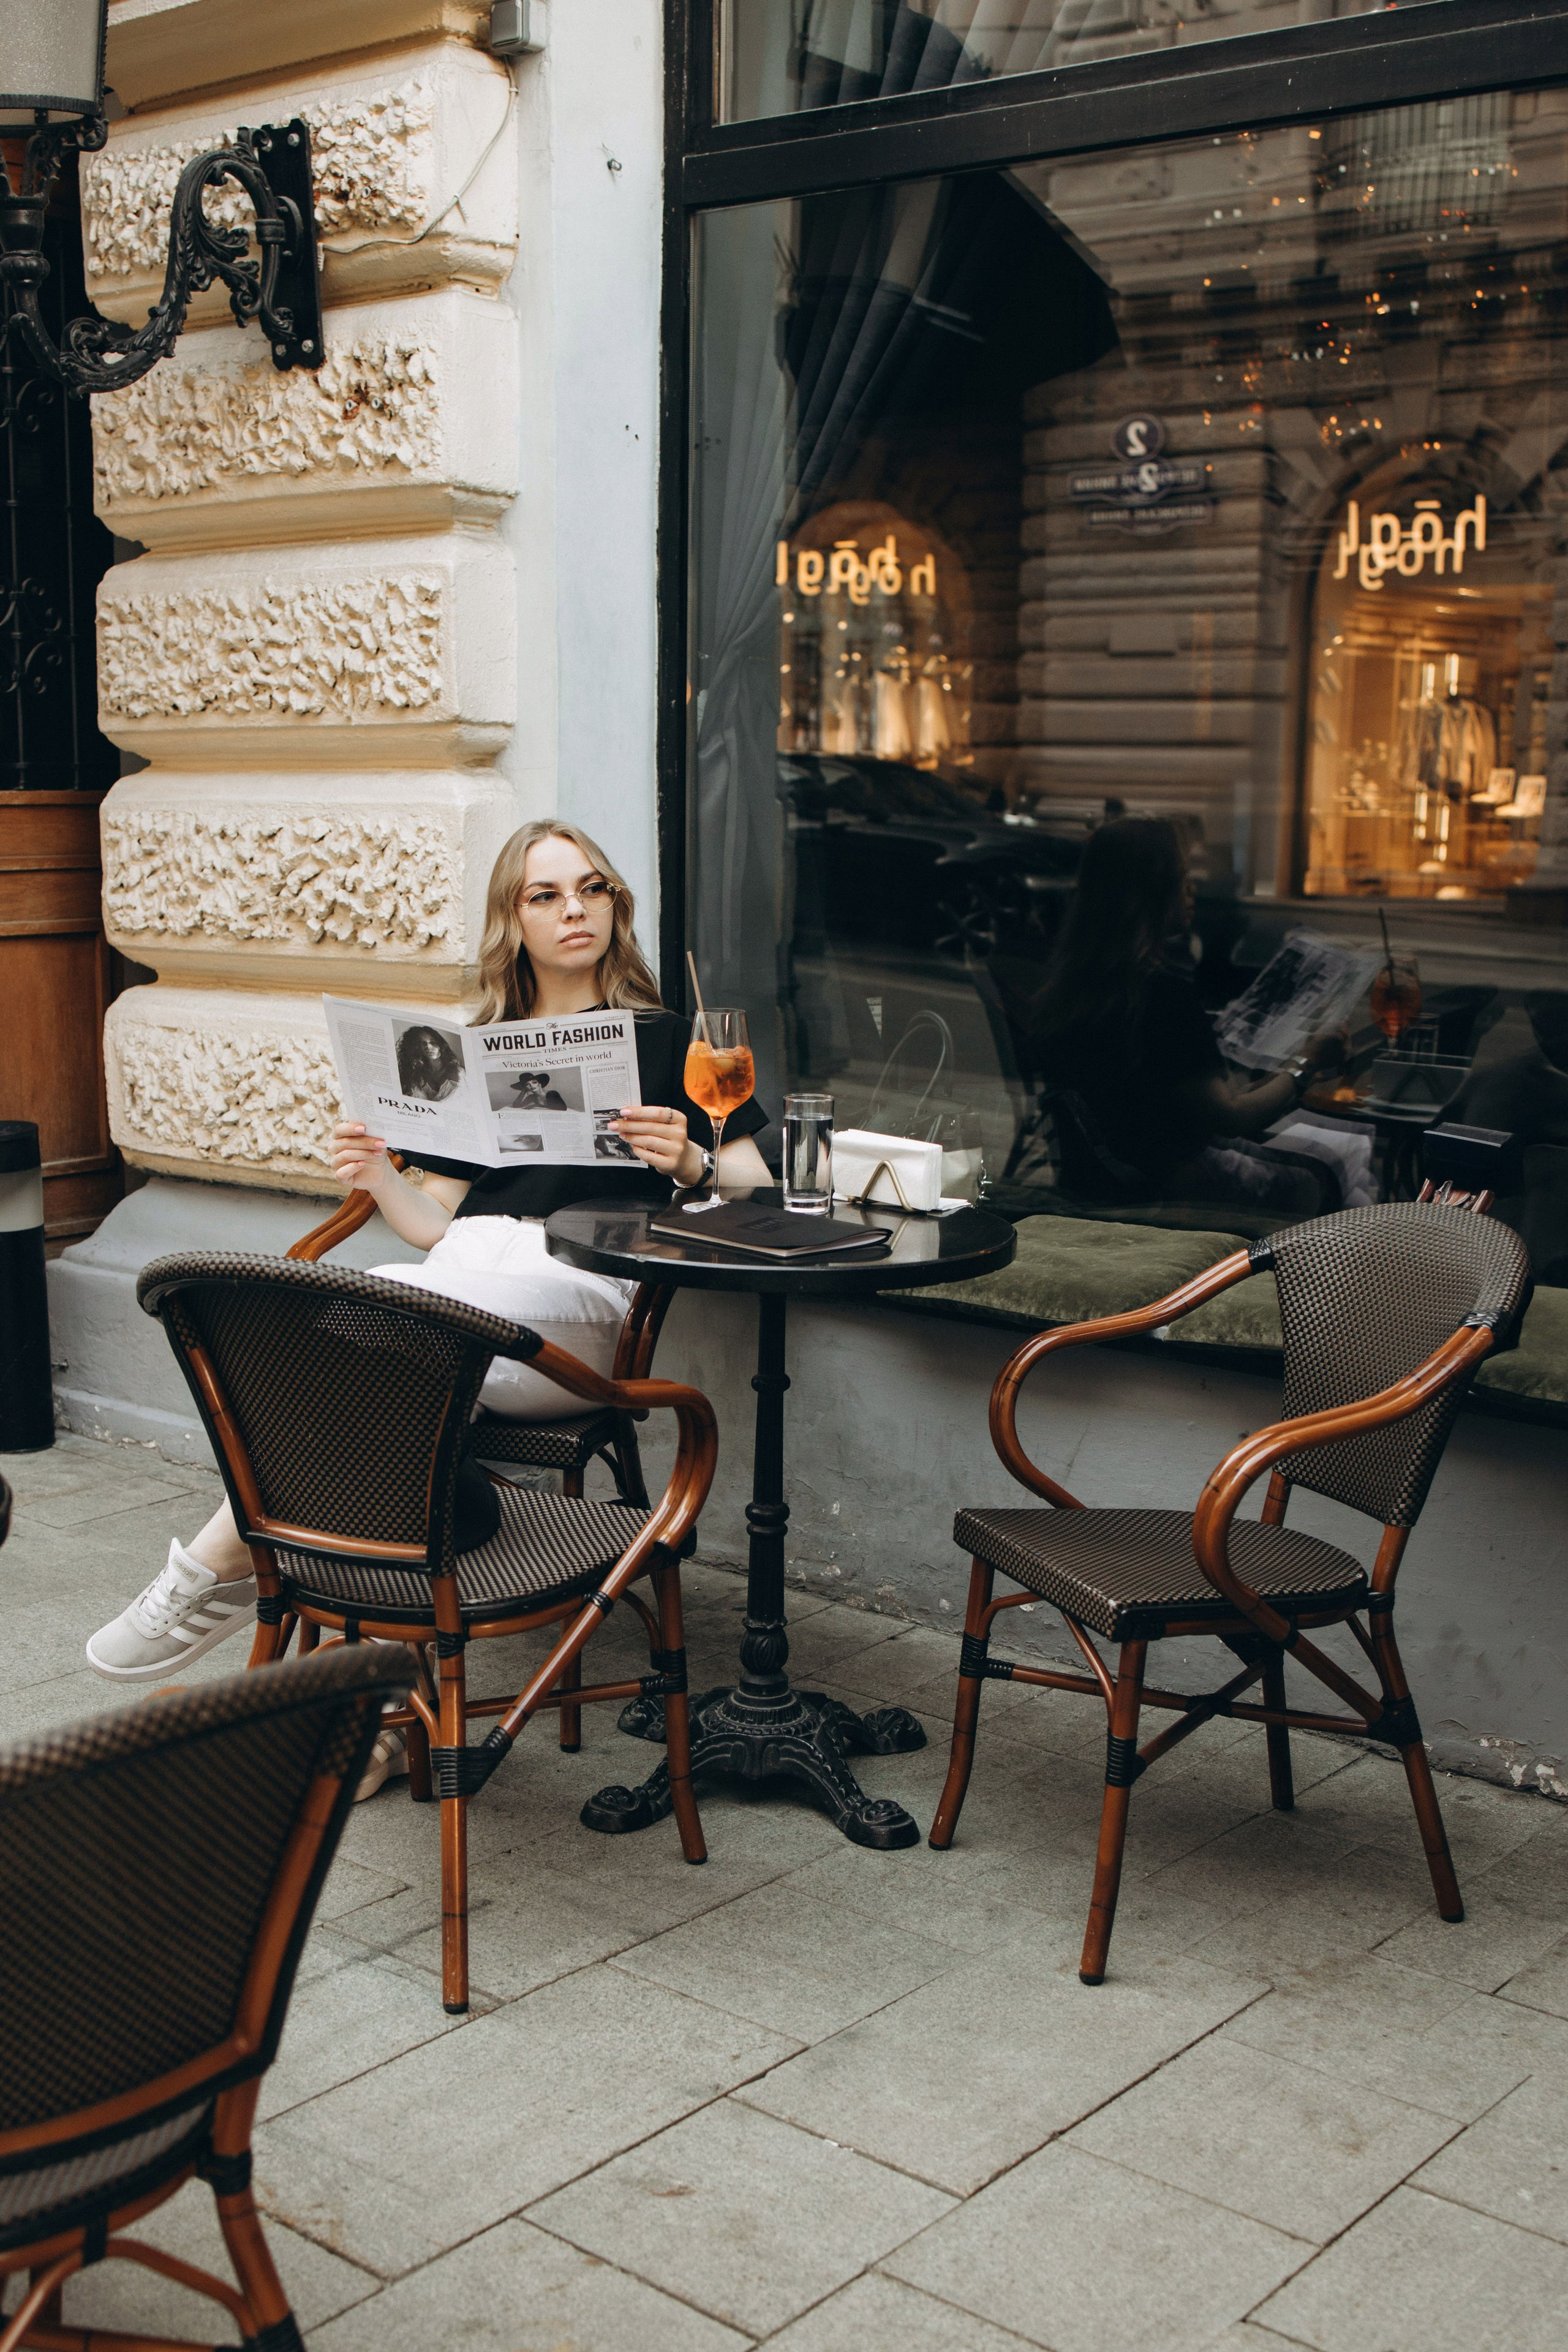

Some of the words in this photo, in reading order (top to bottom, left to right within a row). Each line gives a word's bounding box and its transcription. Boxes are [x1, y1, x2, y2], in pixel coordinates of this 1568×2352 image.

[483, 1033, 546, 1052] WORLD
[552, 1023, 624, 1046] FASHION
[502, 1059, 544, 1069] Victoria's
[545, 1056, 573, 1066] Secret
[586, 1051, 612, 1061] world
[377, 1096, 438, 1115] PRADA
[174, 1558, 194, 1578] adidas
